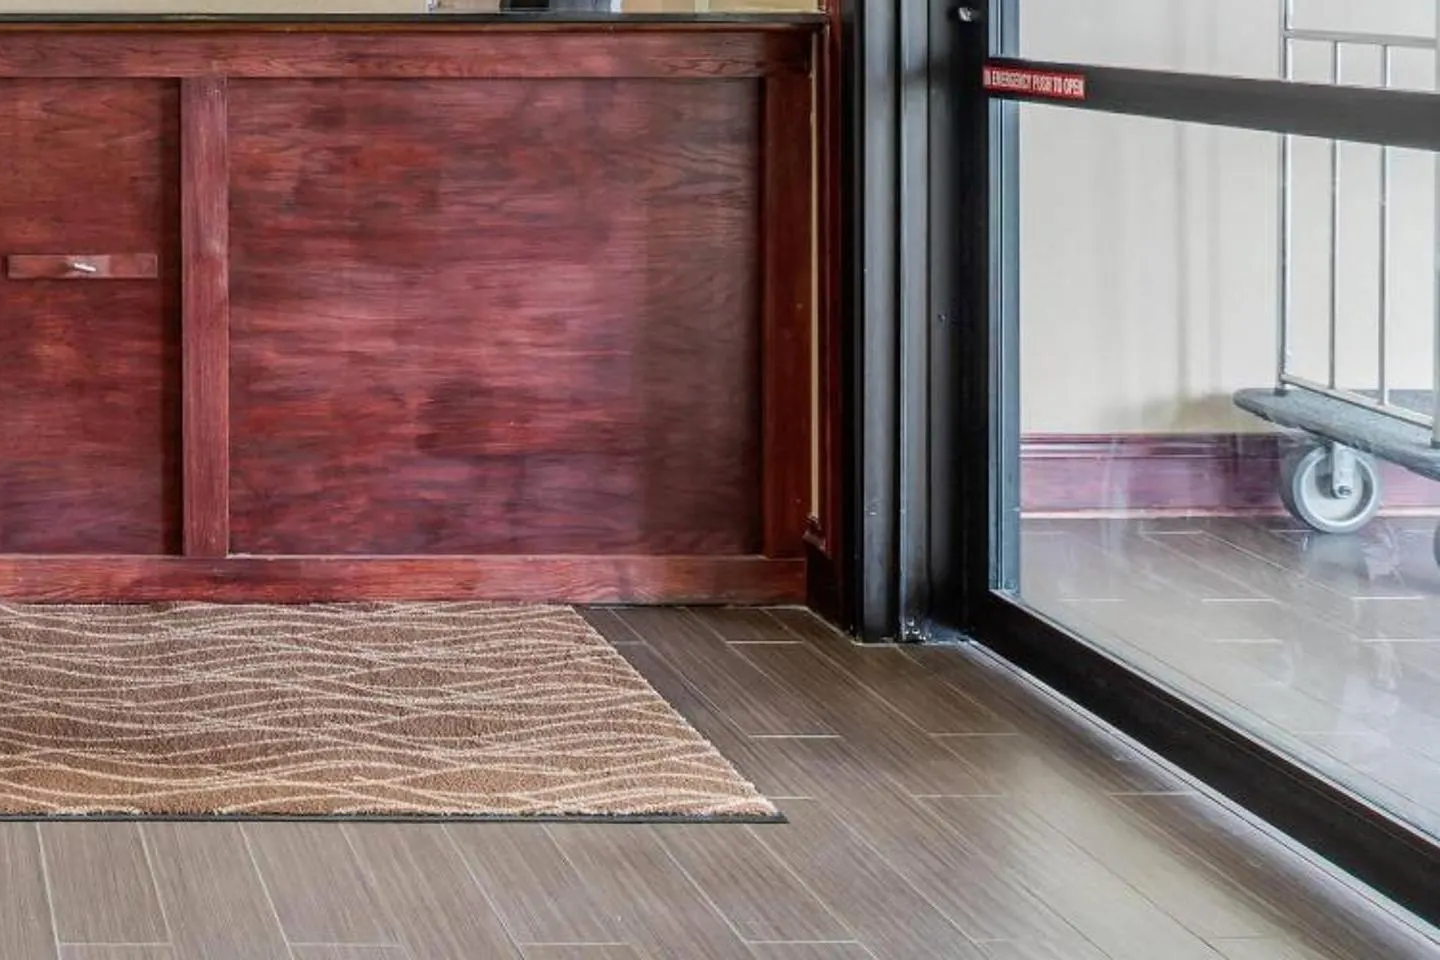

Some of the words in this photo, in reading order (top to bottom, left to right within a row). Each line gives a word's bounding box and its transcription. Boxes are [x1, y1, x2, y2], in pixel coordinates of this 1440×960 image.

[992, 70, 1031, 90] EMERGENCY
[1032, 73, 1052, 93] PUSH
[1053, 75, 1062, 93] TO
[1063, 77, 1084, 97] OPEN
